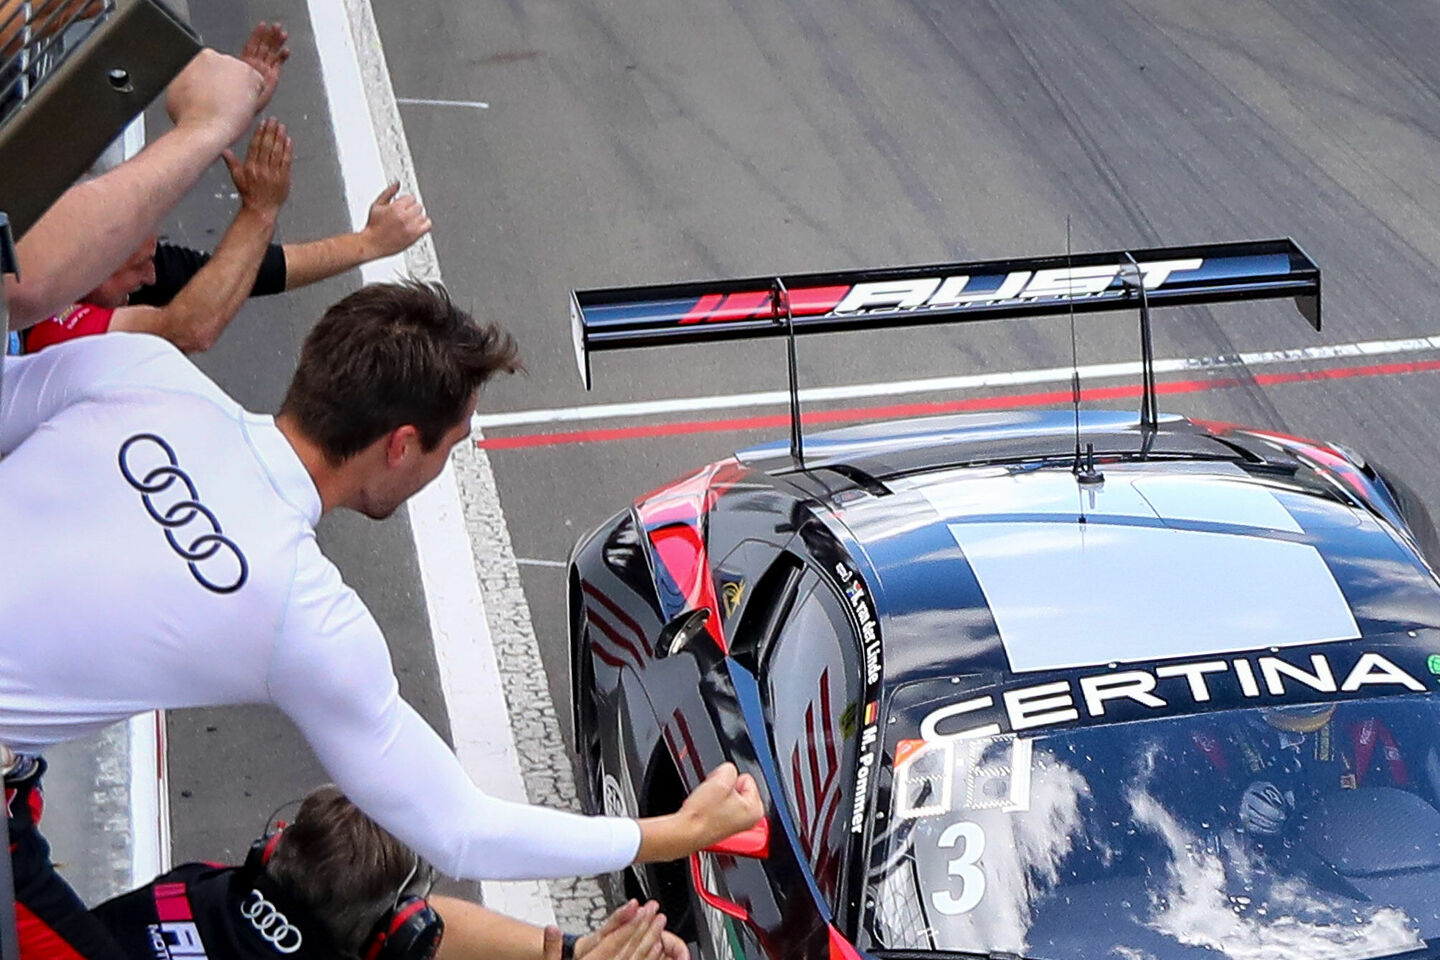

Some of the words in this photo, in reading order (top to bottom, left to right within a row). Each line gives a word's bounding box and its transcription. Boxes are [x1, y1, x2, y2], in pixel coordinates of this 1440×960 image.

[829, 258, 1203, 315] AUST
[866, 640, 882, 686] Linde
[919, 652, 1426, 742] CERTINA
[860, 725, 878, 752] M.
[851, 752, 875, 834] Pommer
[931, 821, 985, 915] 3
